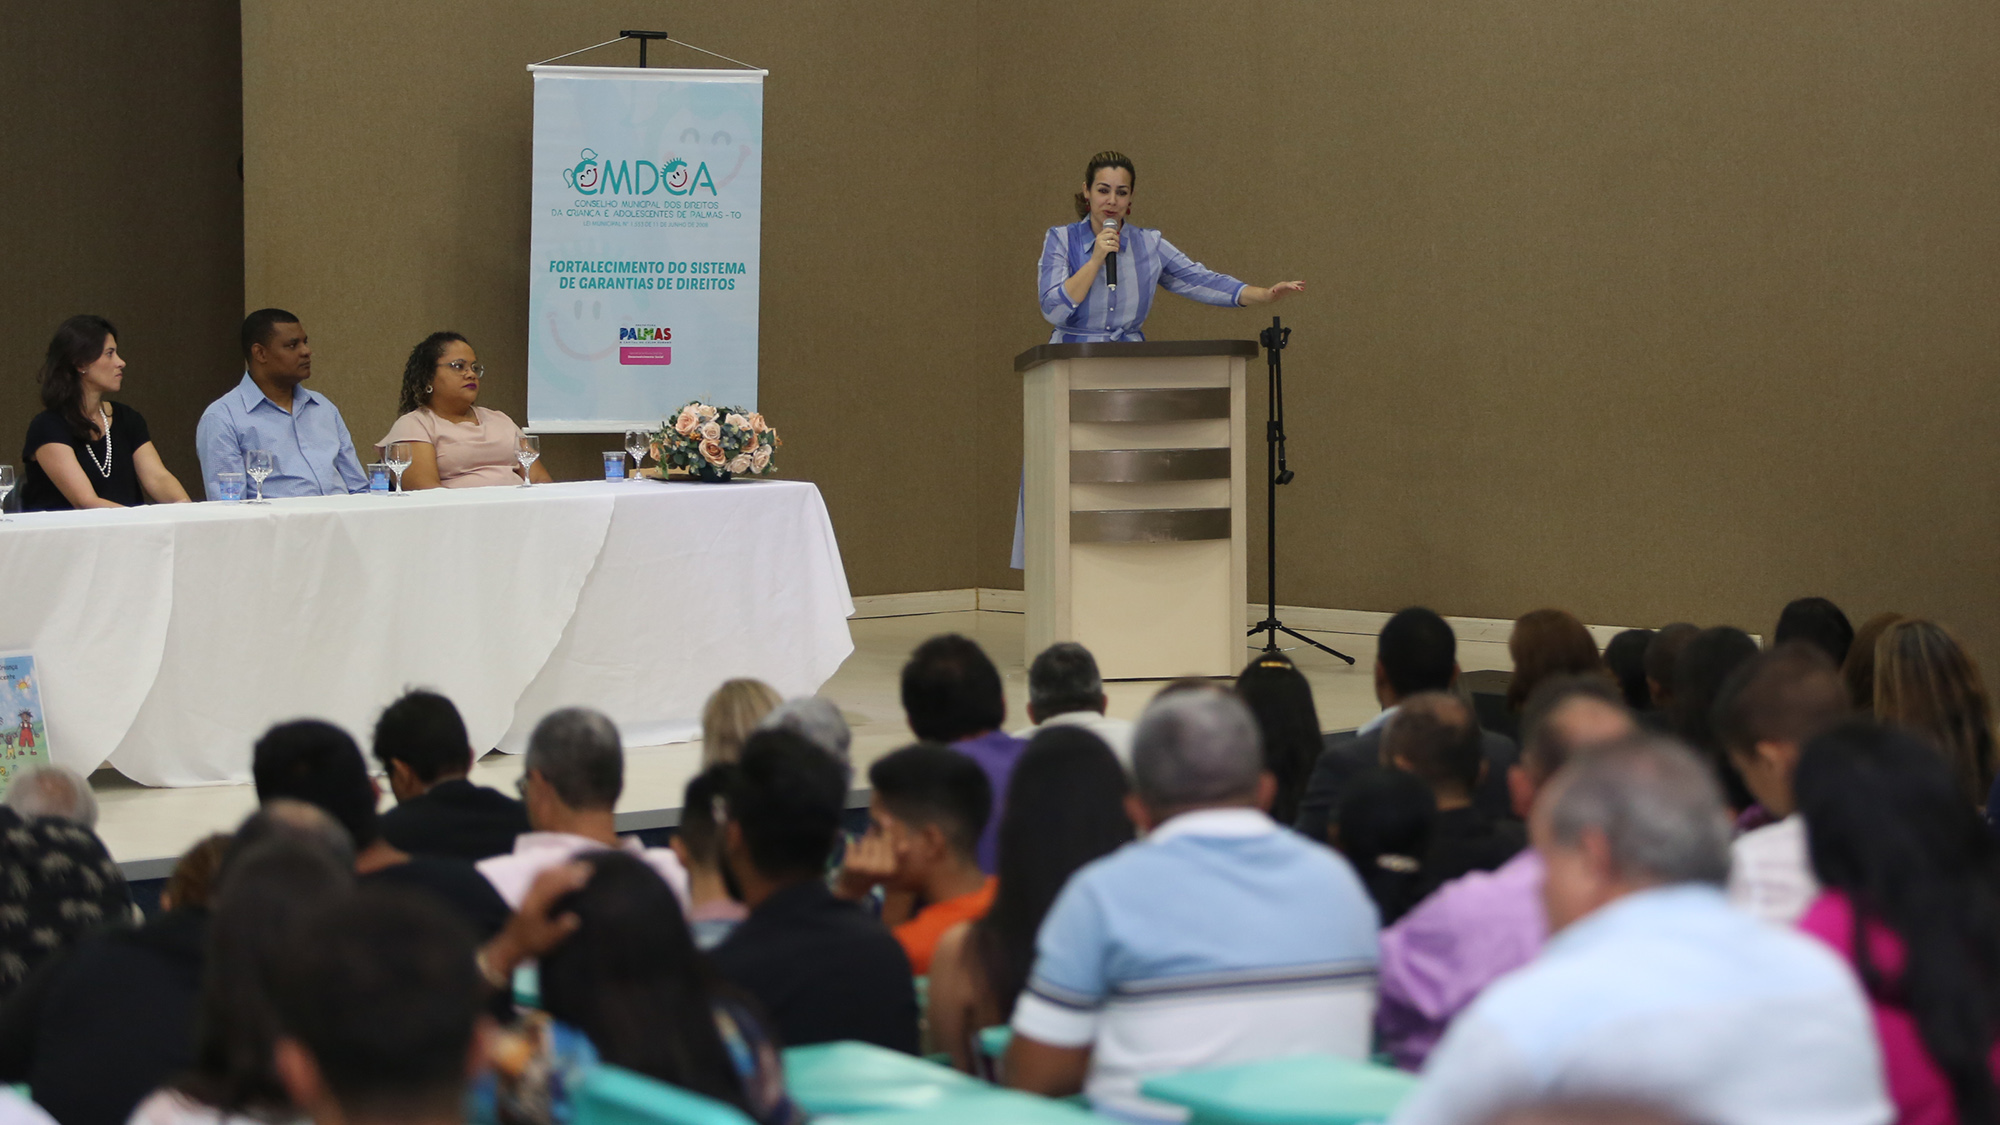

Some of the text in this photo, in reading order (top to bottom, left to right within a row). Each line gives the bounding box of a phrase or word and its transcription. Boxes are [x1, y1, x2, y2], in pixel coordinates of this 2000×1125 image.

[573, 158, 718, 196] CMDCA
[574, 199, 719, 209] CONSELHO MUNICIPAL DOS DIREITOS
[551, 208, 563, 216] DA
[566, 209, 601, 217] CRIANÇA
[604, 209, 609, 217] E
[613, 209, 674, 218] ADOLESCENTES
[677, 210, 686, 218] DE
[690, 211, 723, 219] PALMAS
[730, 211, 742, 219] TO
[549, 260, 746, 274] FORTALECIMENTO DO SISTEMA
[559, 276, 735, 290] DE GARANTIAS DE DIREITOS
[619, 327, 672, 340] PALMAS
